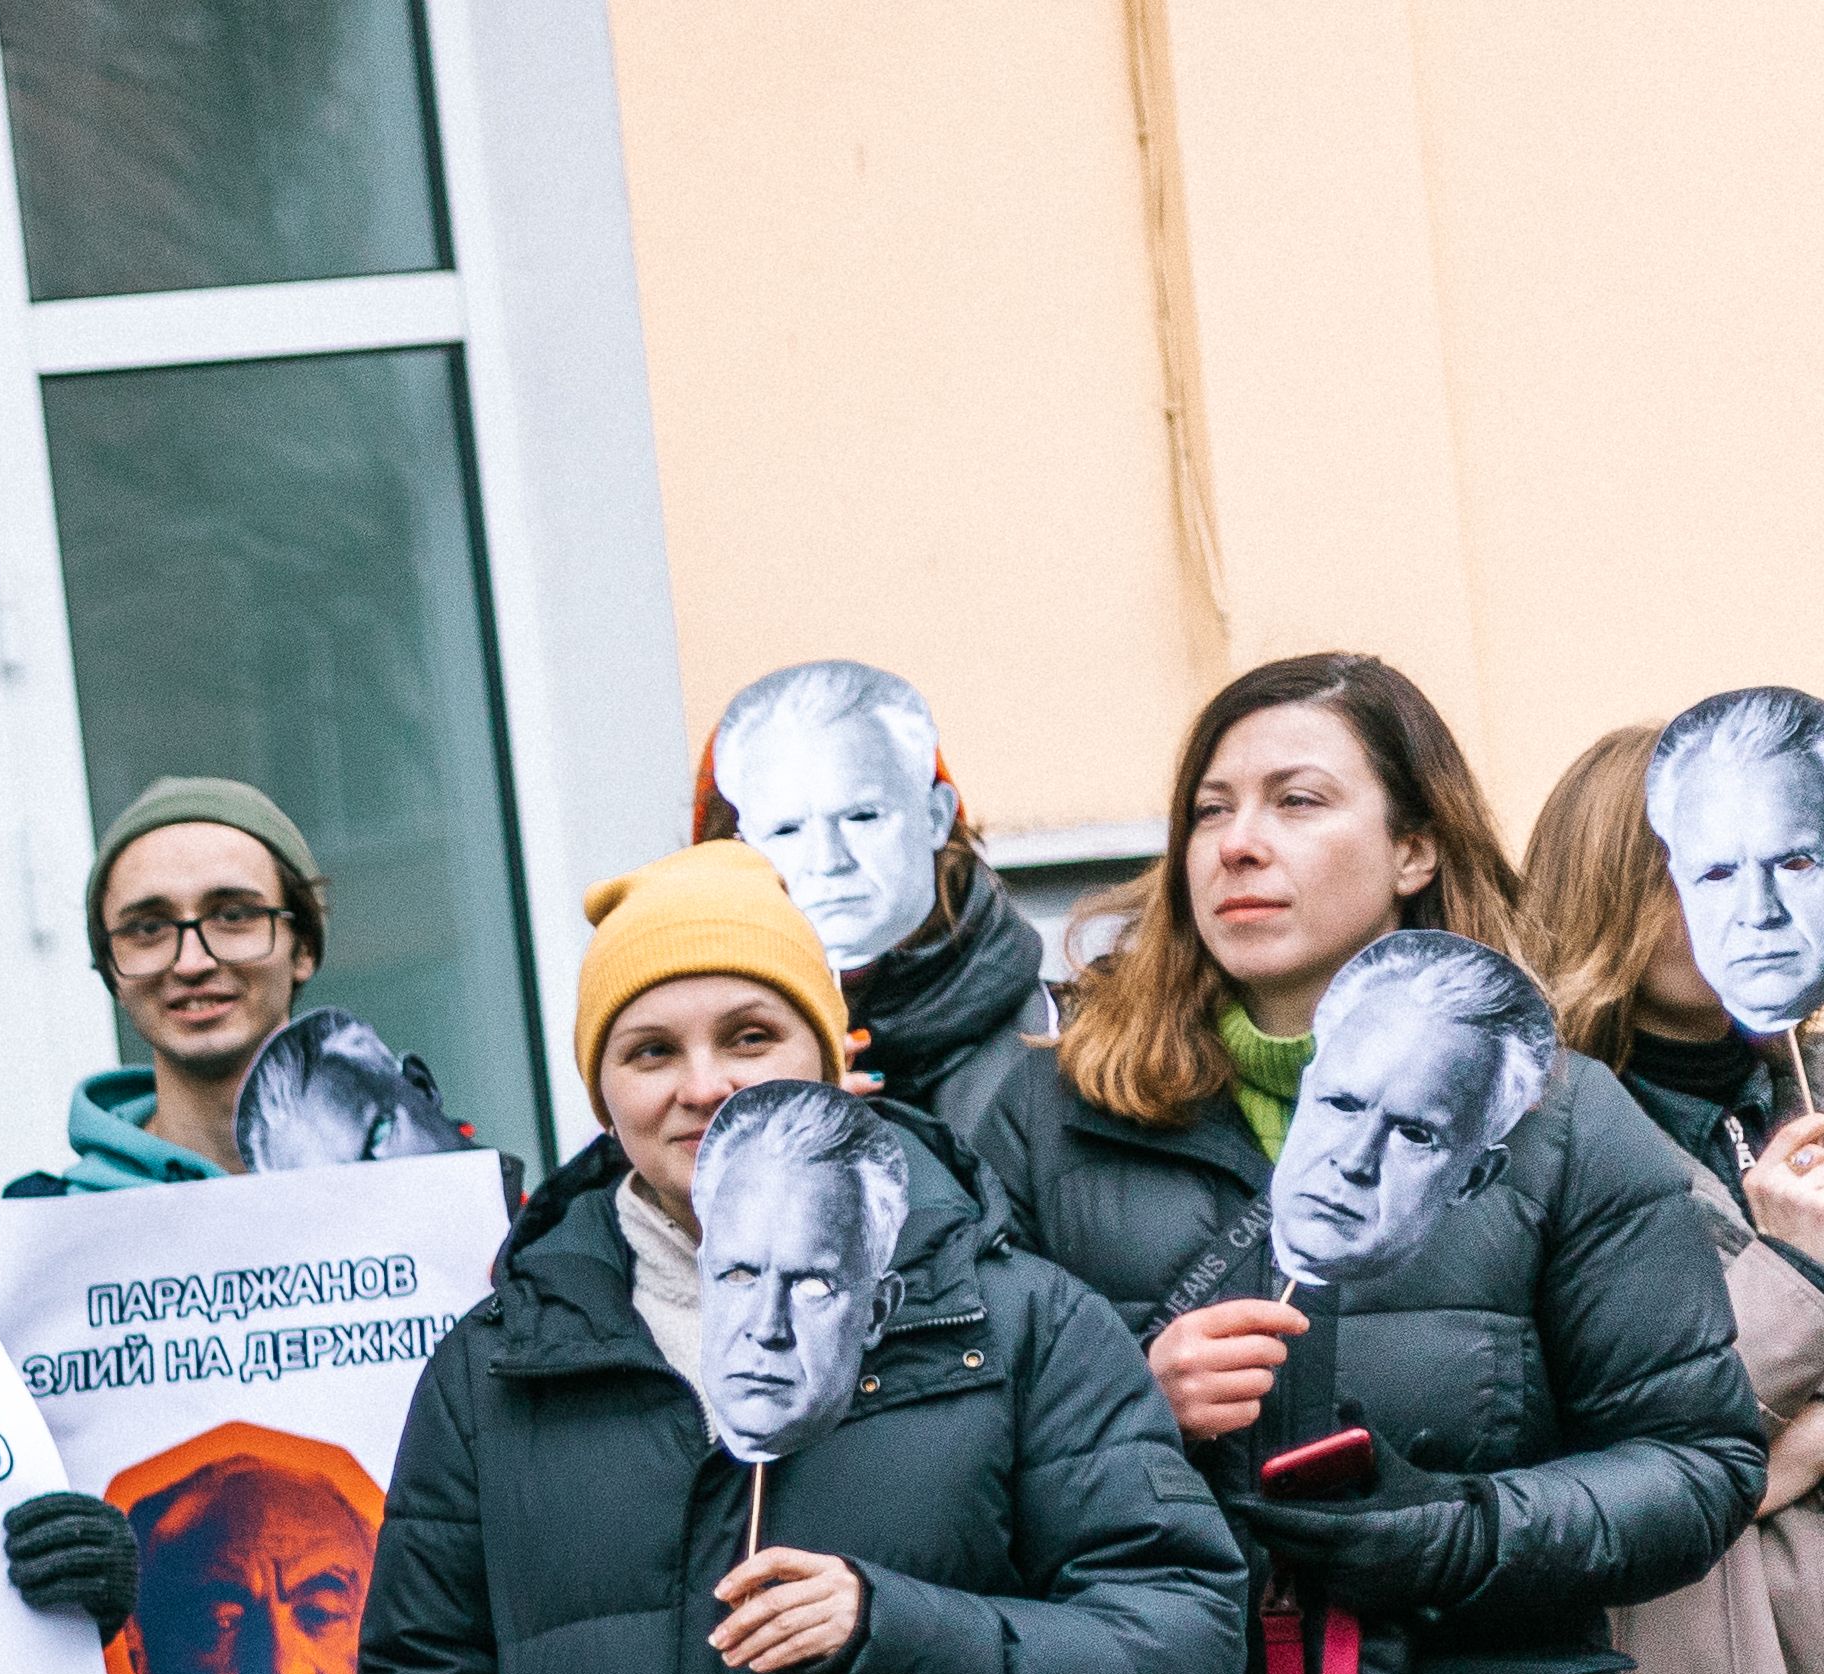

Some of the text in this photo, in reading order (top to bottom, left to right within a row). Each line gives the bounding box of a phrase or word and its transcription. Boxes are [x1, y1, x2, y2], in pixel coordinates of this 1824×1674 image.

[88, 1254, 418, 1328] ПАРАДЖАНОВ
[1165, 1253, 1228, 1317] JEANS
[22, 1314, 457, 1398] ЗЛИЙ НА ДЕРЖКІН
